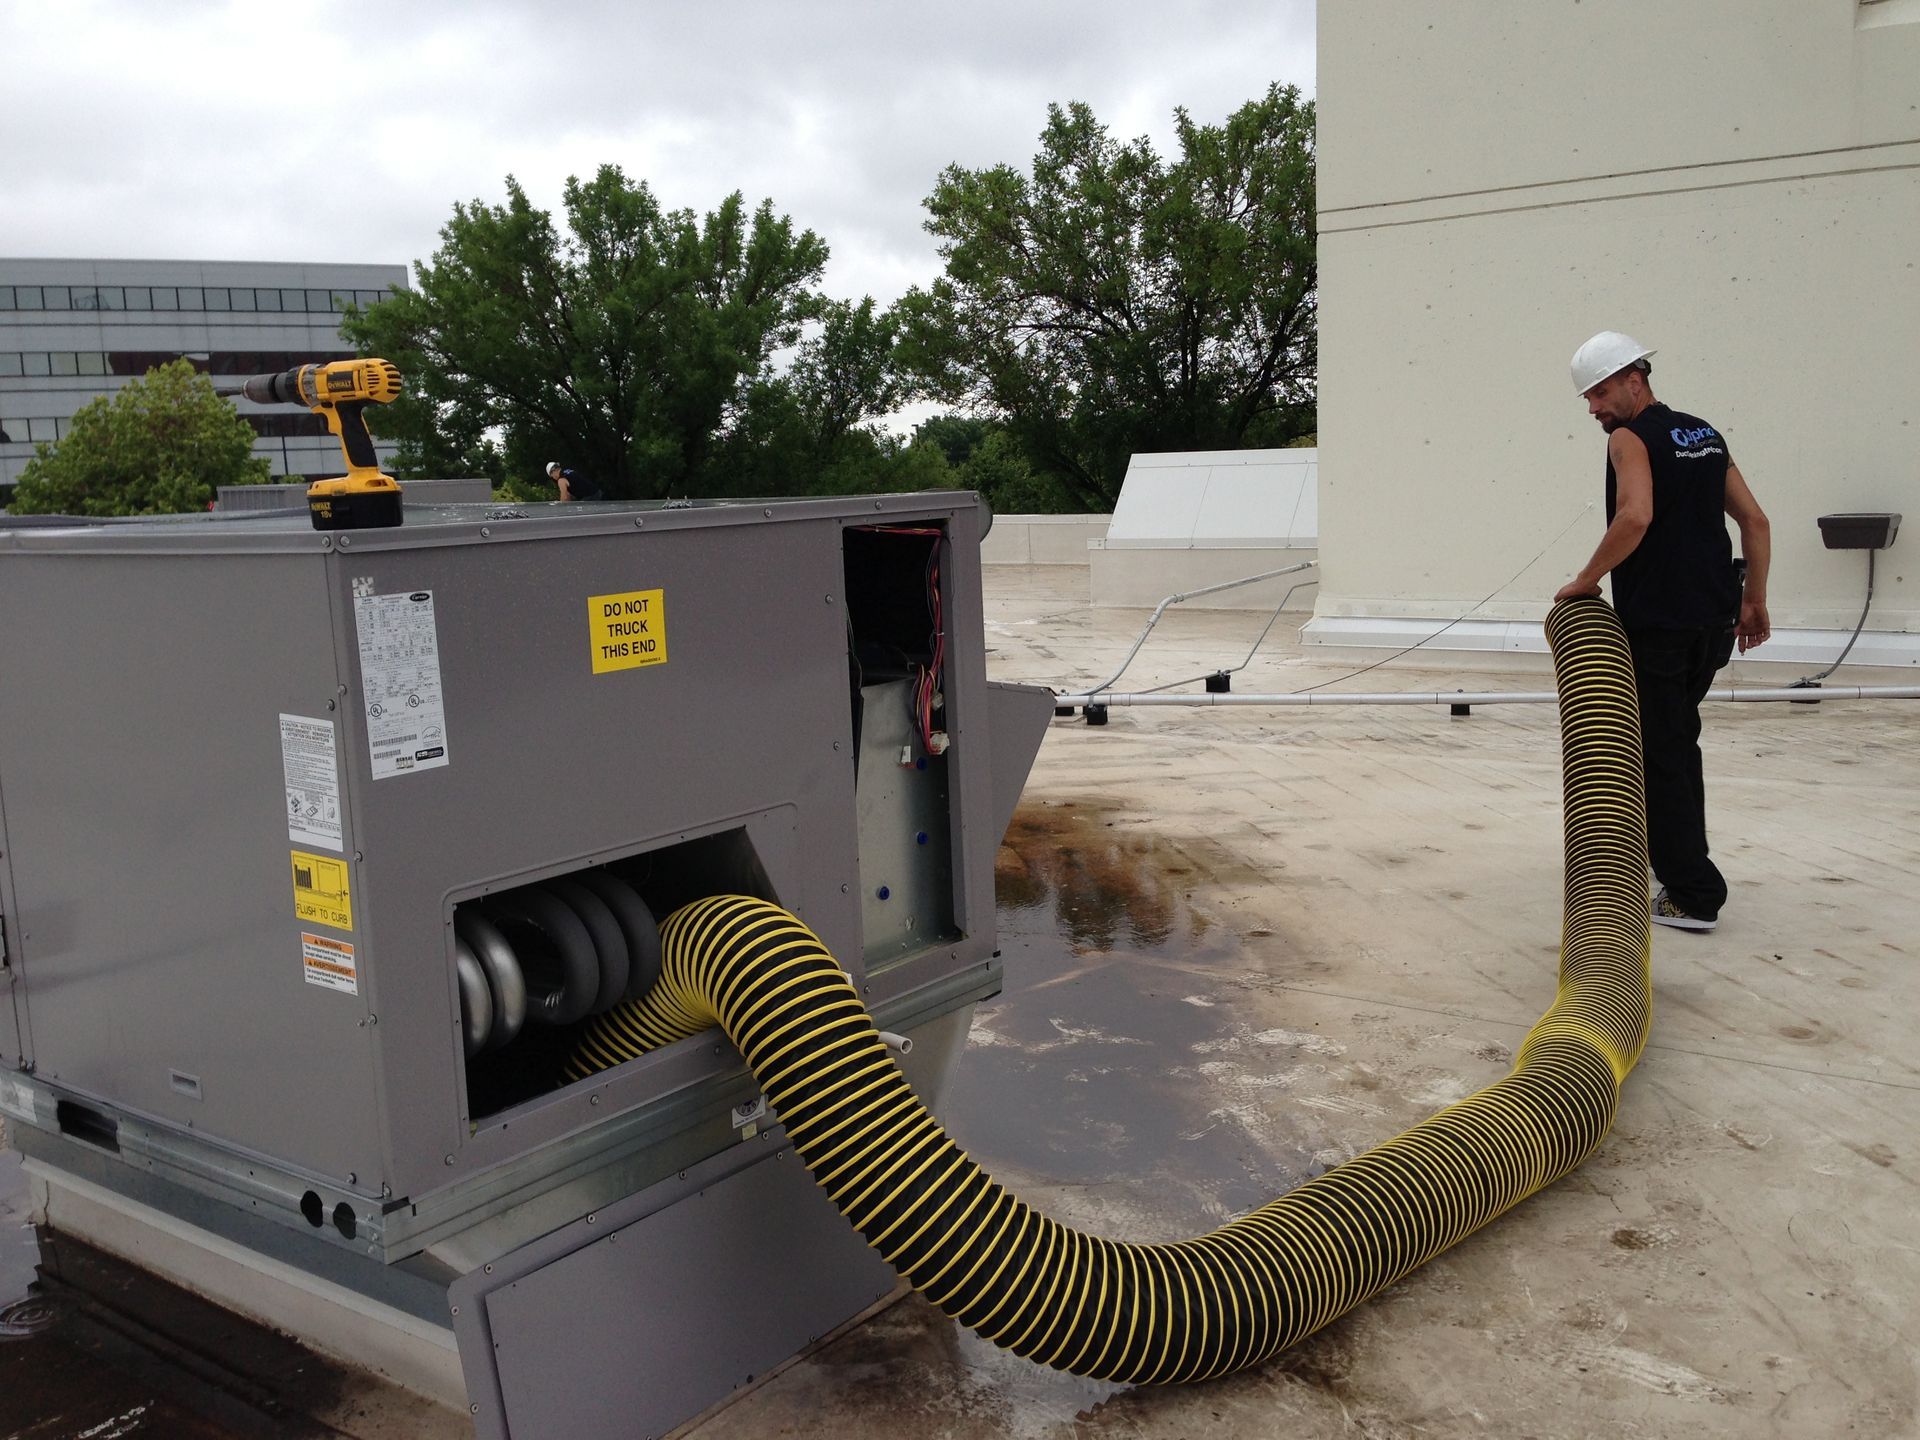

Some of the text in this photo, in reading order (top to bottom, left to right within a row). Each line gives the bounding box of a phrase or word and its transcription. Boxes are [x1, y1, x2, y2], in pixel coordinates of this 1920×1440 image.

[603, 599, 649, 617] DO NOT
[607, 620, 648, 637] TRUCK
[601, 639, 656, 659] THIS END
[296, 902, 348, 924] FLUSH TO CURB
